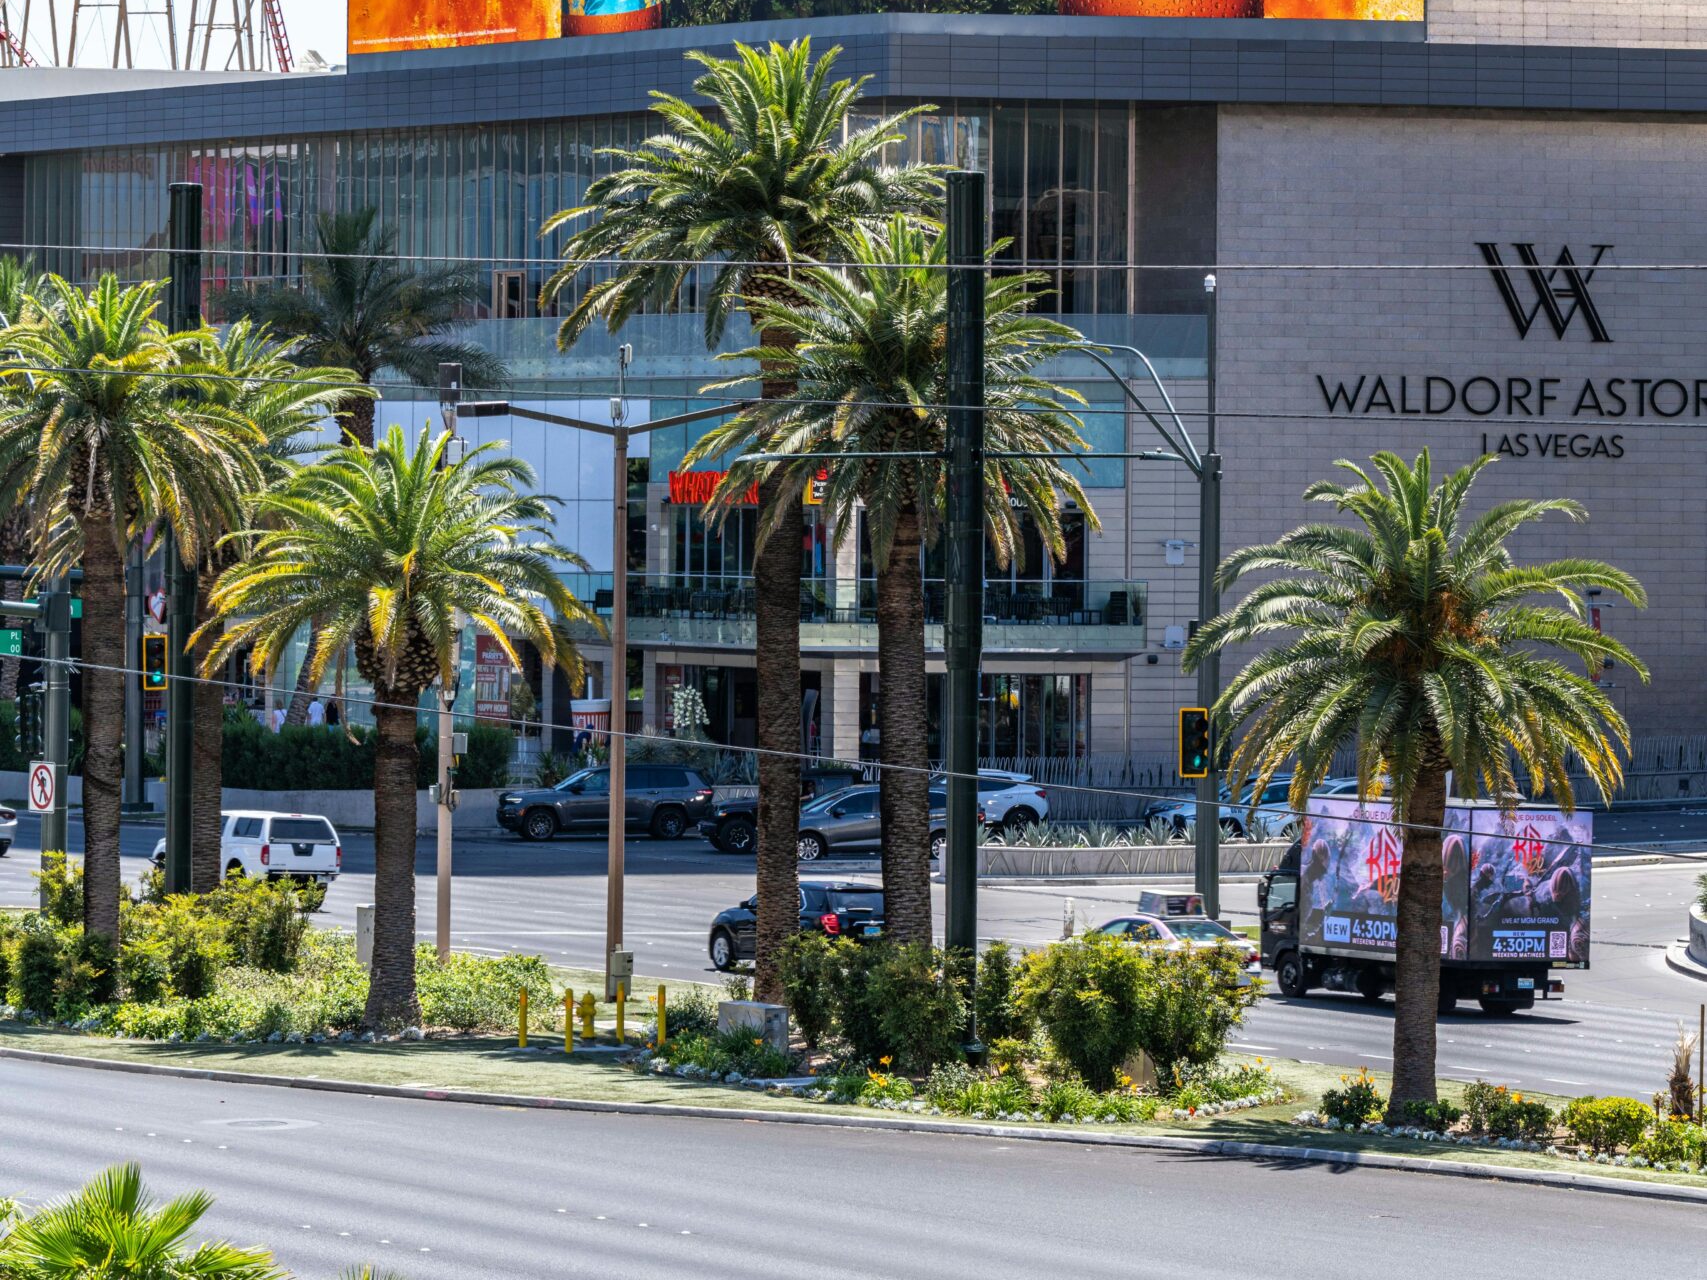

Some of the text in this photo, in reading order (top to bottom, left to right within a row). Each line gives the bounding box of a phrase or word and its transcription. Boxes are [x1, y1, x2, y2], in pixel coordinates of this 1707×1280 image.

[1316, 374, 1561, 417] WALDORF
[1534, 433, 1625, 459] VEGAS
[1535, 814, 1557, 822] SOLEIL
[1326, 923, 1348, 936] NEW
[1352, 937, 1376, 946] WEEKEND
[1492, 938, 1545, 952] 4:30PM
